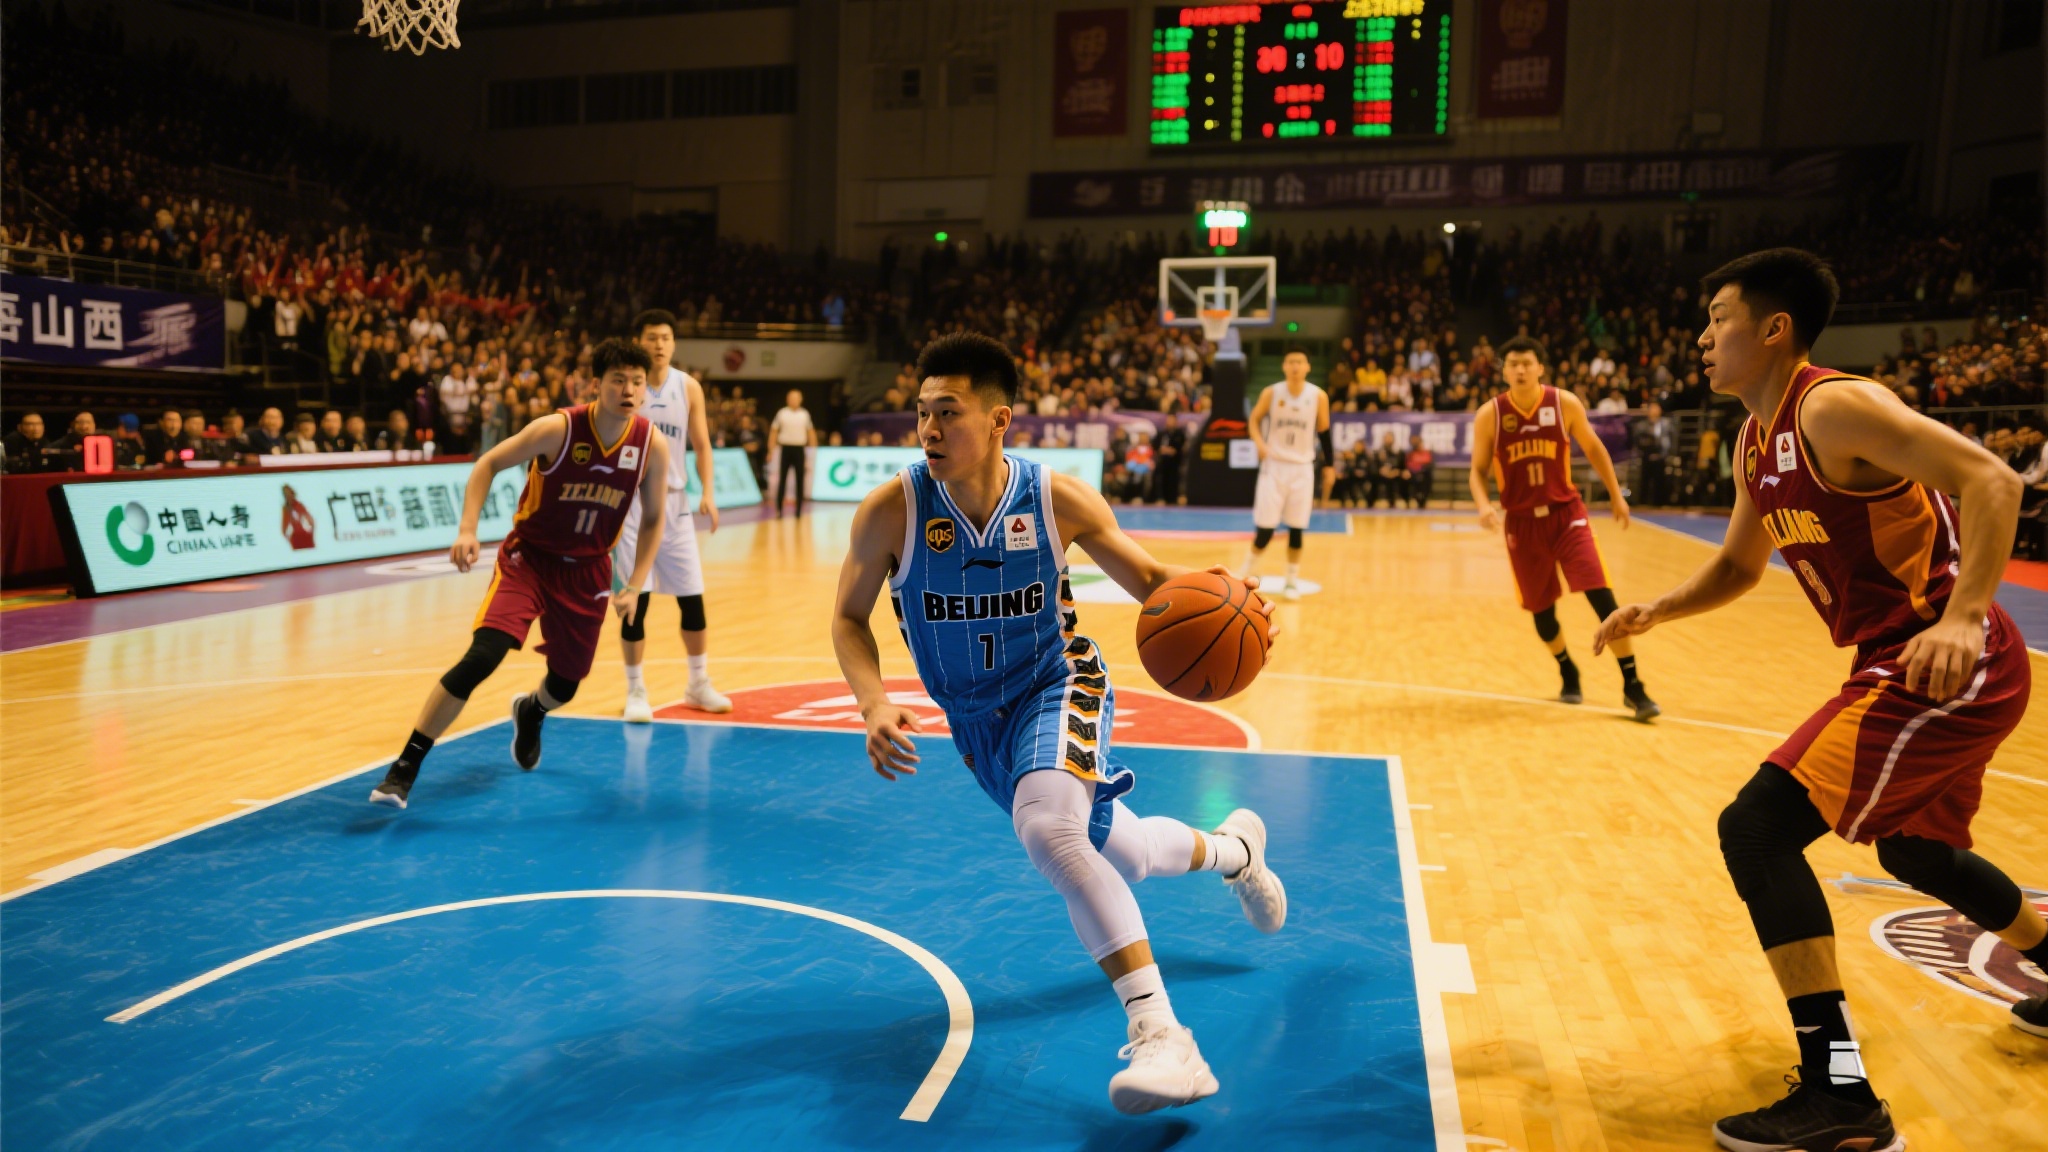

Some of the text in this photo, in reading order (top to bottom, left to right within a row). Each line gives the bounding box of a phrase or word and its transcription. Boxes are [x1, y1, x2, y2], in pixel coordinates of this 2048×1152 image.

[1526, 462, 1545, 487] 11
[574, 509, 599, 535] 11
[922, 581, 1045, 623] BEIJING
